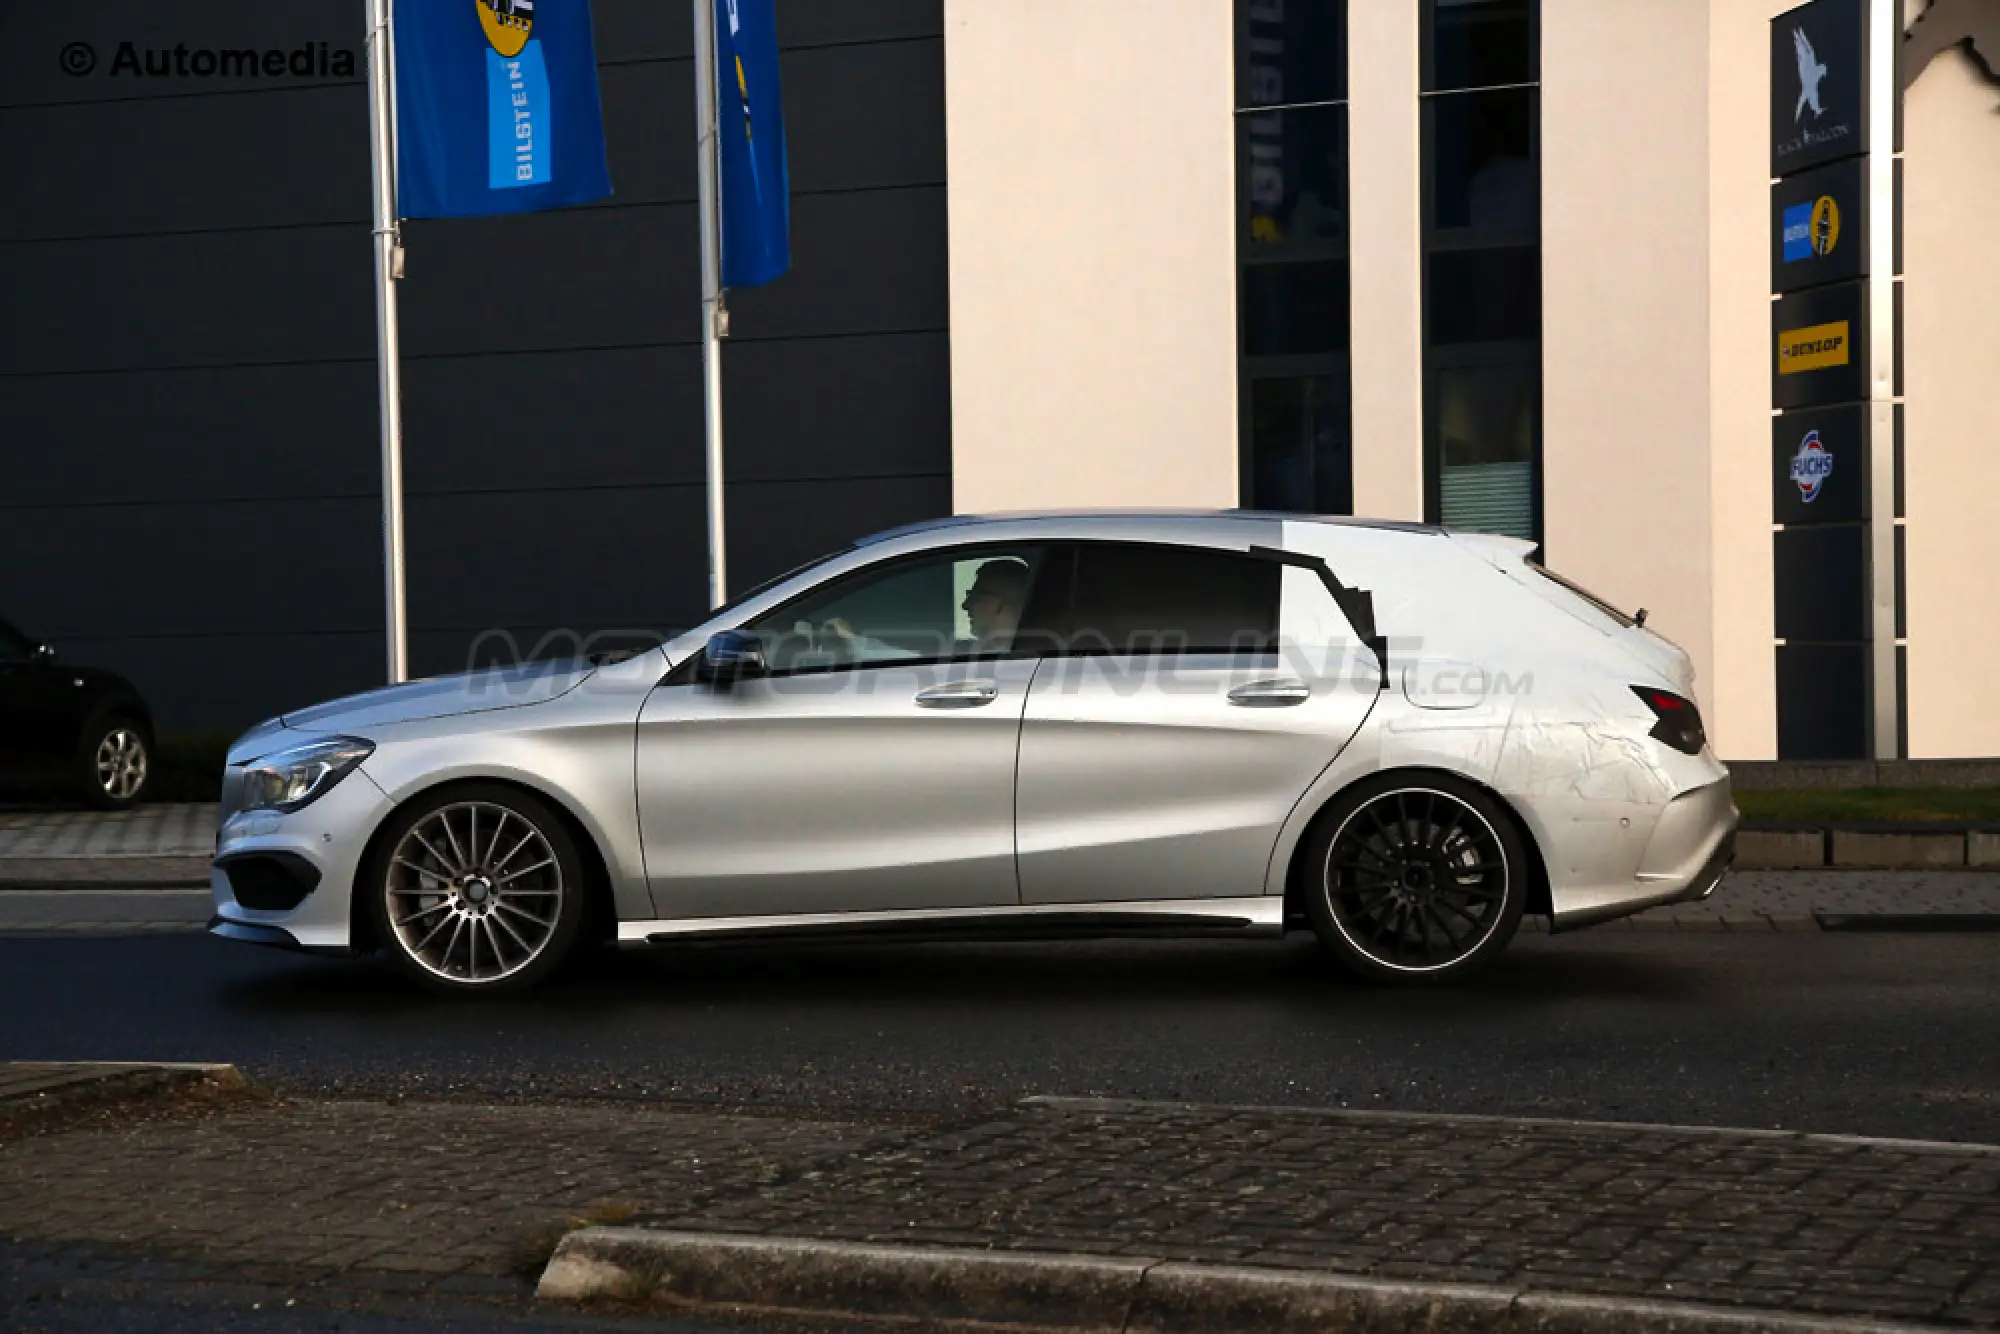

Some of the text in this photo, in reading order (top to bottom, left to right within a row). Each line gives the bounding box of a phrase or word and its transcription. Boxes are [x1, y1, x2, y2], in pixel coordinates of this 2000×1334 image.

[504, 60, 533, 181] BILSTEIN
[1791, 335, 1843, 357] DUNLOP
[1792, 454, 1832, 477] FUCHS
